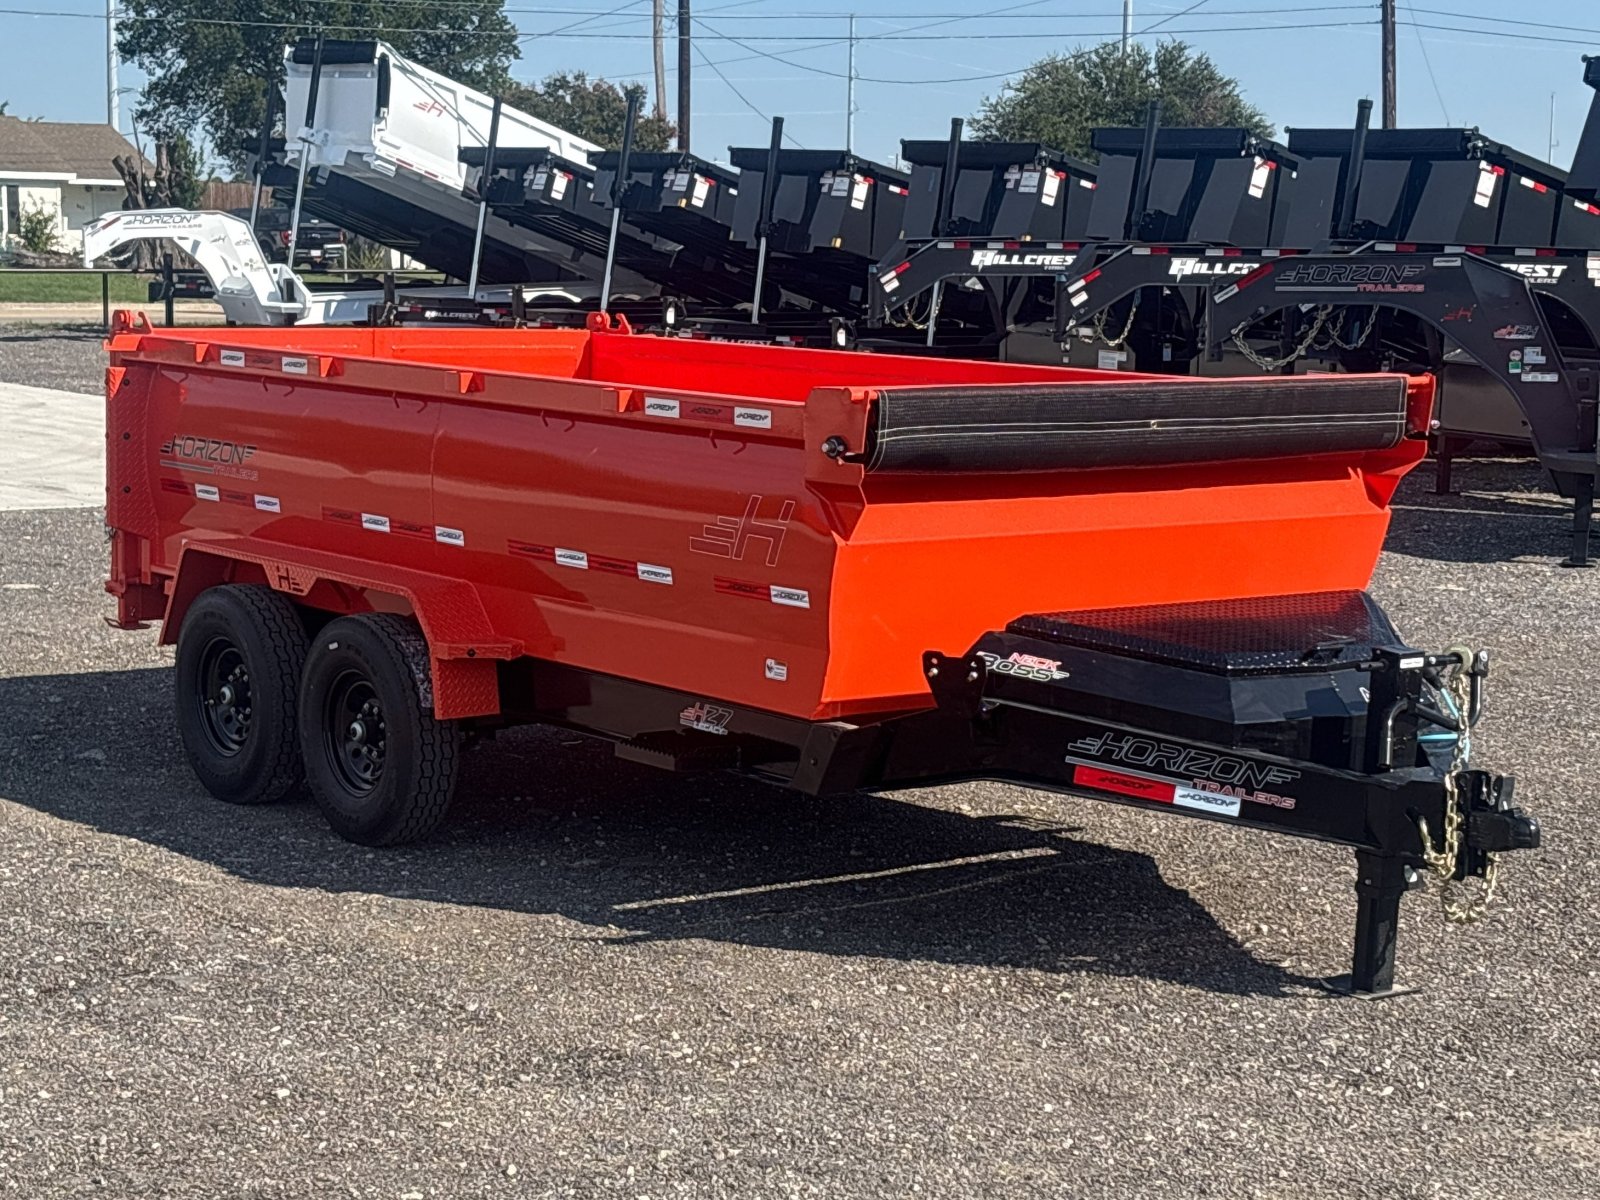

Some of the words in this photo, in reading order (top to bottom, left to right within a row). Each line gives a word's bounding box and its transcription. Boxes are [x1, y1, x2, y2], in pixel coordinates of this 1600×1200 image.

[123, 213, 201, 226] HORIZON
[1275, 264, 1426, 283] HORIZON
[1356, 283, 1426, 293] TRAILERS
[424, 310, 480, 320] HILLCREST
[160, 433, 257, 465] HORIZON
[1008, 652, 1060, 670] NECK
[1067, 732, 1301, 788] HORIZON
[1100, 774, 1156, 791] HORIZON
[1178, 792, 1238, 808] HORIZON
[1192, 778, 1296, 809] TRAILERS
